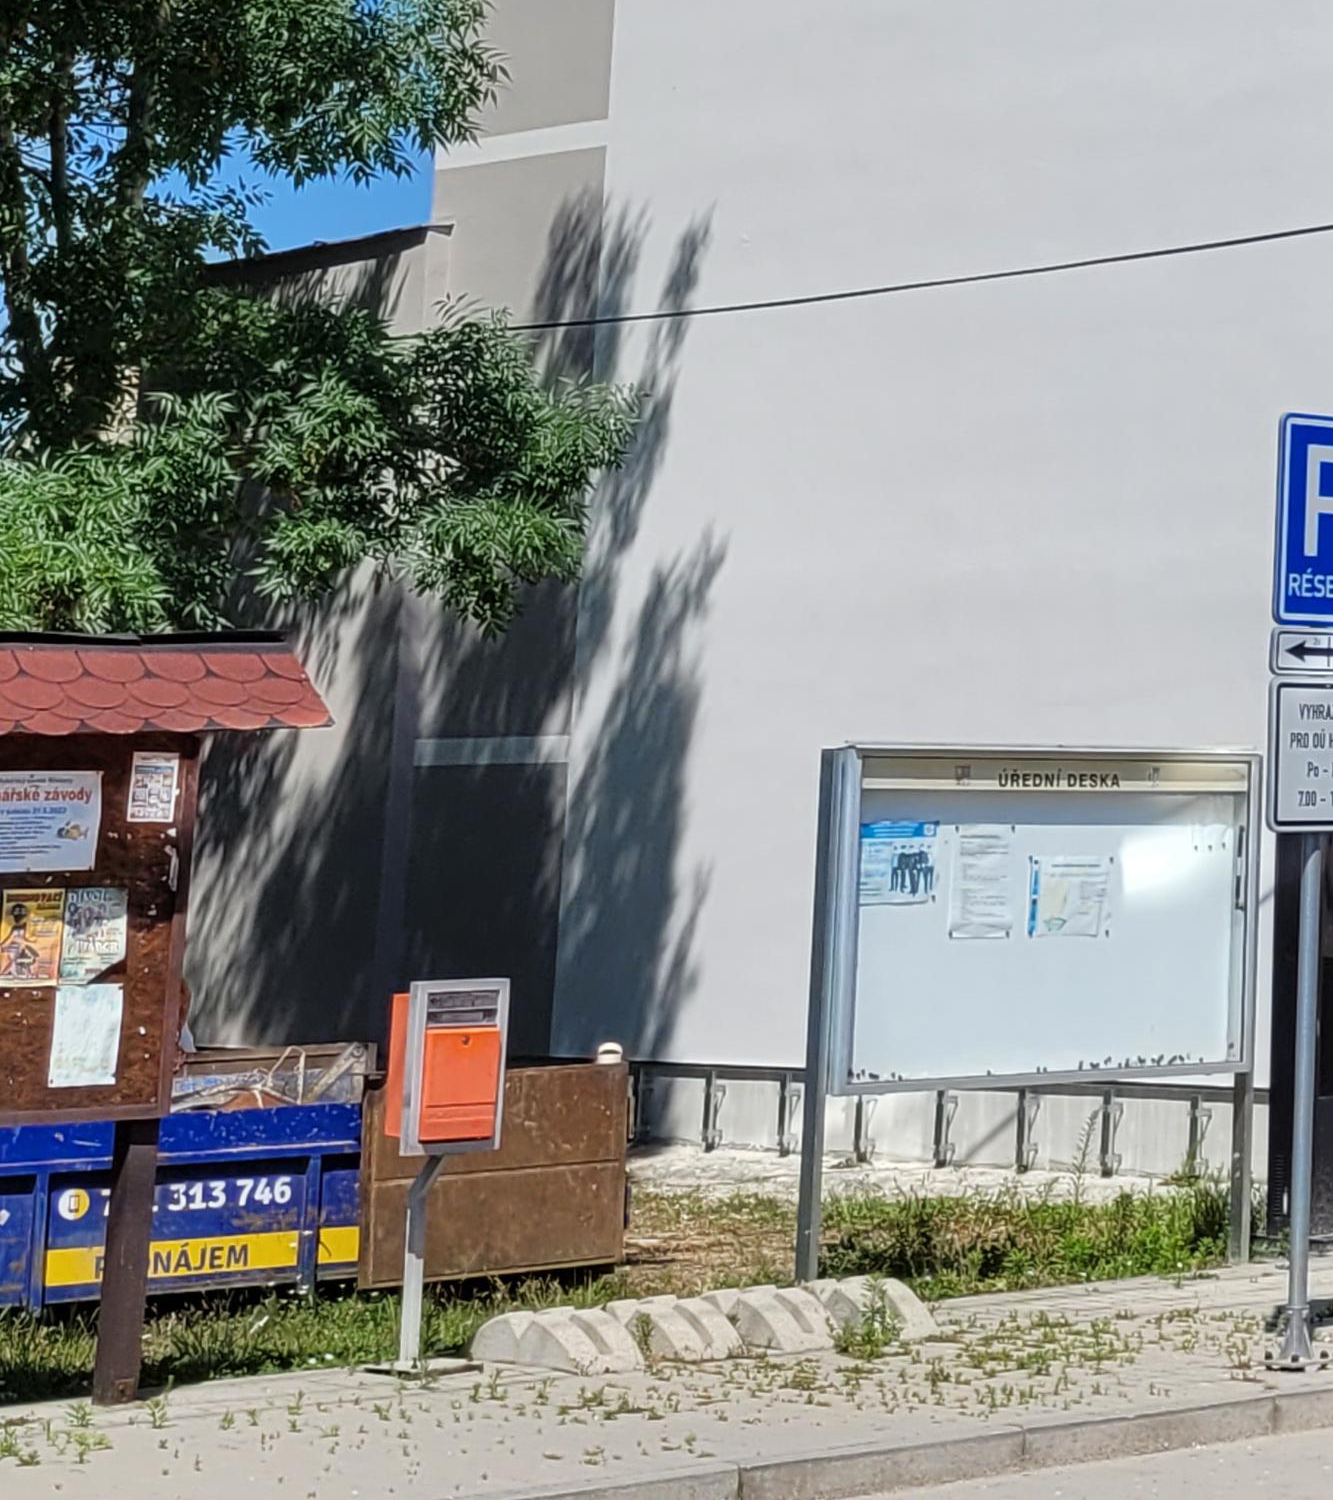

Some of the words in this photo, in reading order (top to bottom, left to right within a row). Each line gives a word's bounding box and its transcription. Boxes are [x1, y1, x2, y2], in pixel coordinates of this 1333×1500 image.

[1290, 732, 1309, 749] PRO
[998, 768, 1062, 788] ÚŘEDNÍ
[1067, 773, 1121, 788] DESKA
[1307, 761, 1320, 778] Po
[44, 786, 92, 804] závody
[168, 1180, 226, 1211] 313
[236, 1176, 292, 1206] 746
[95, 1243, 249, 1279] PNÁJEM
